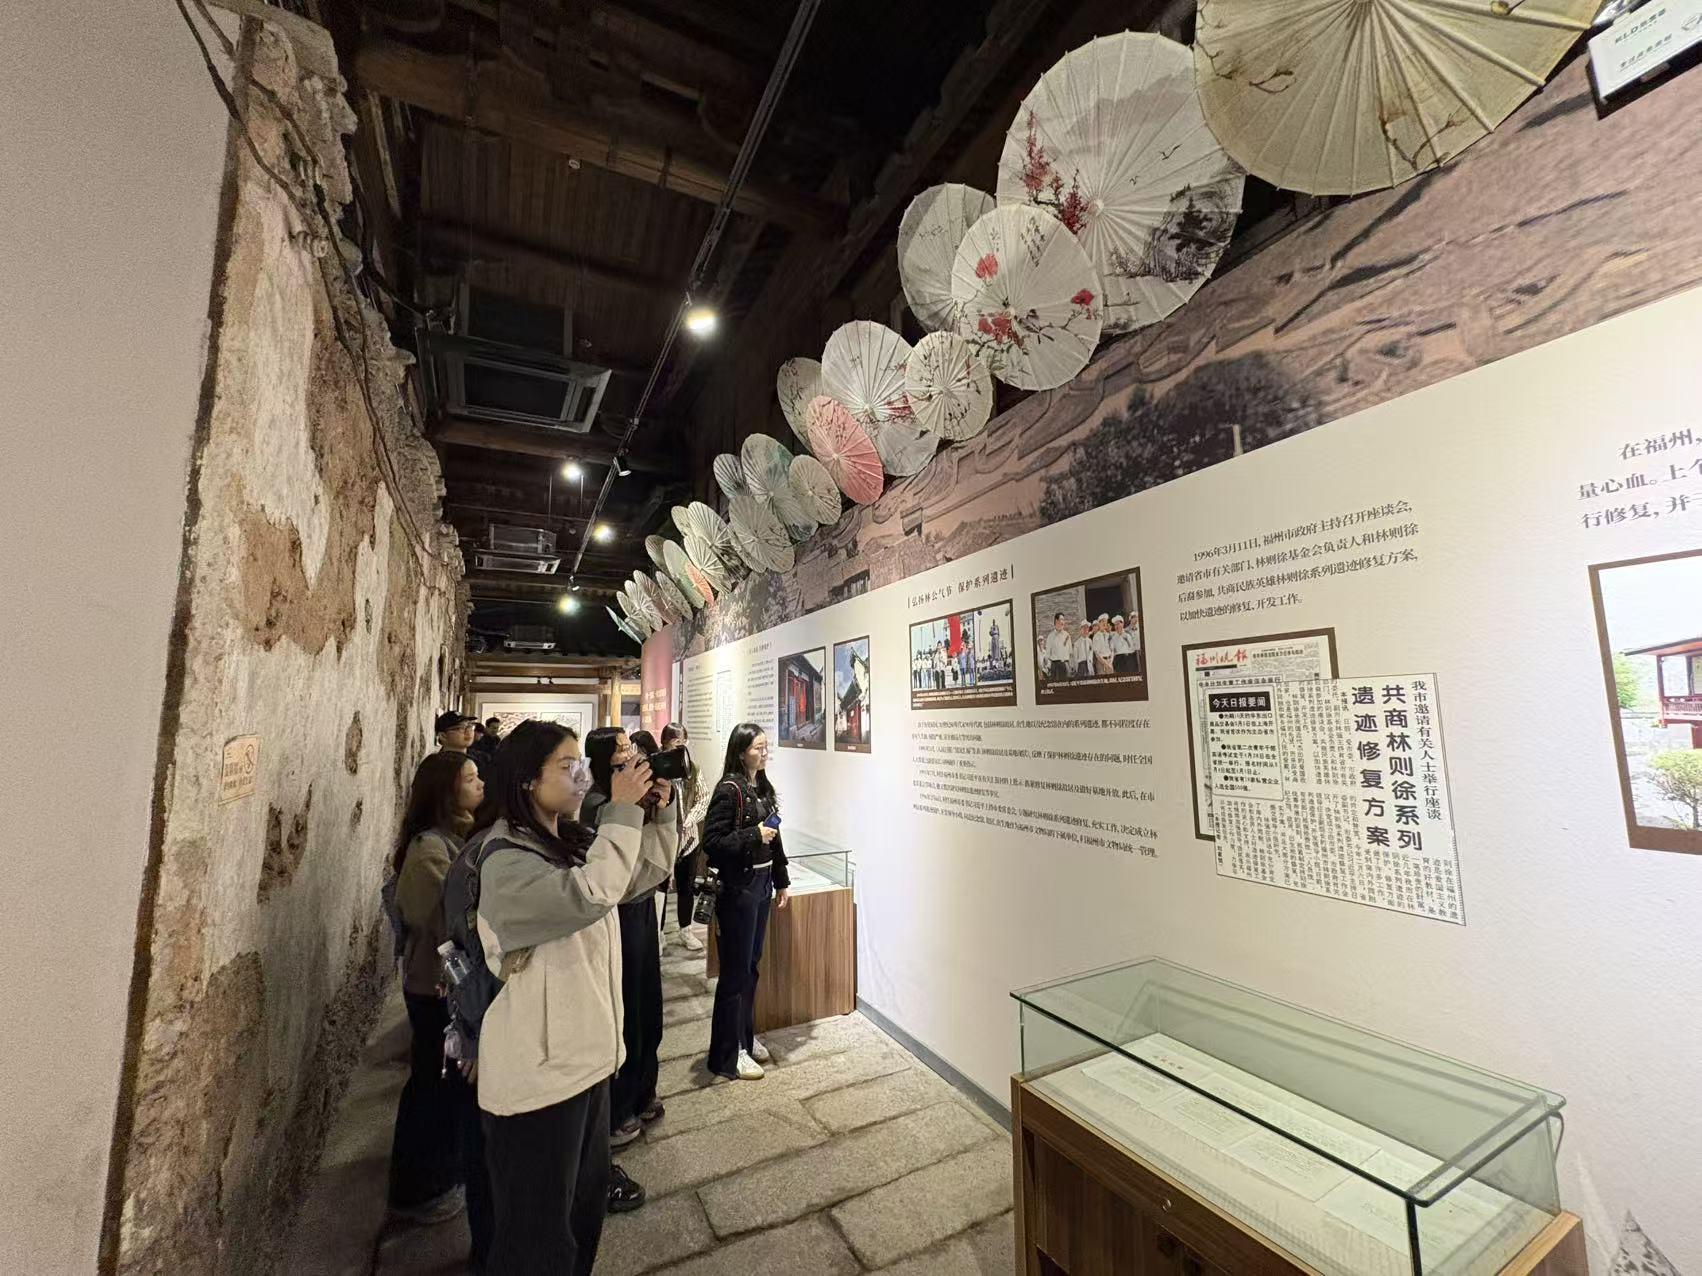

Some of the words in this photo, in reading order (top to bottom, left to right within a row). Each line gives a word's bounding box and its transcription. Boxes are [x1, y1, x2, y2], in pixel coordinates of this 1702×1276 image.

[1581, 491, 1702, 529] 行修复,并
[957, 568, 1008, 594] 保护系列遗迹
[1212, 696, 1266, 709] 今天日报要闻
[1351, 685, 1390, 848] 遗迹修复方案
[1382, 685, 1422, 851] 共商林则徐系列
[1411, 680, 1442, 821] 我市邀请有关人士举行座谈
